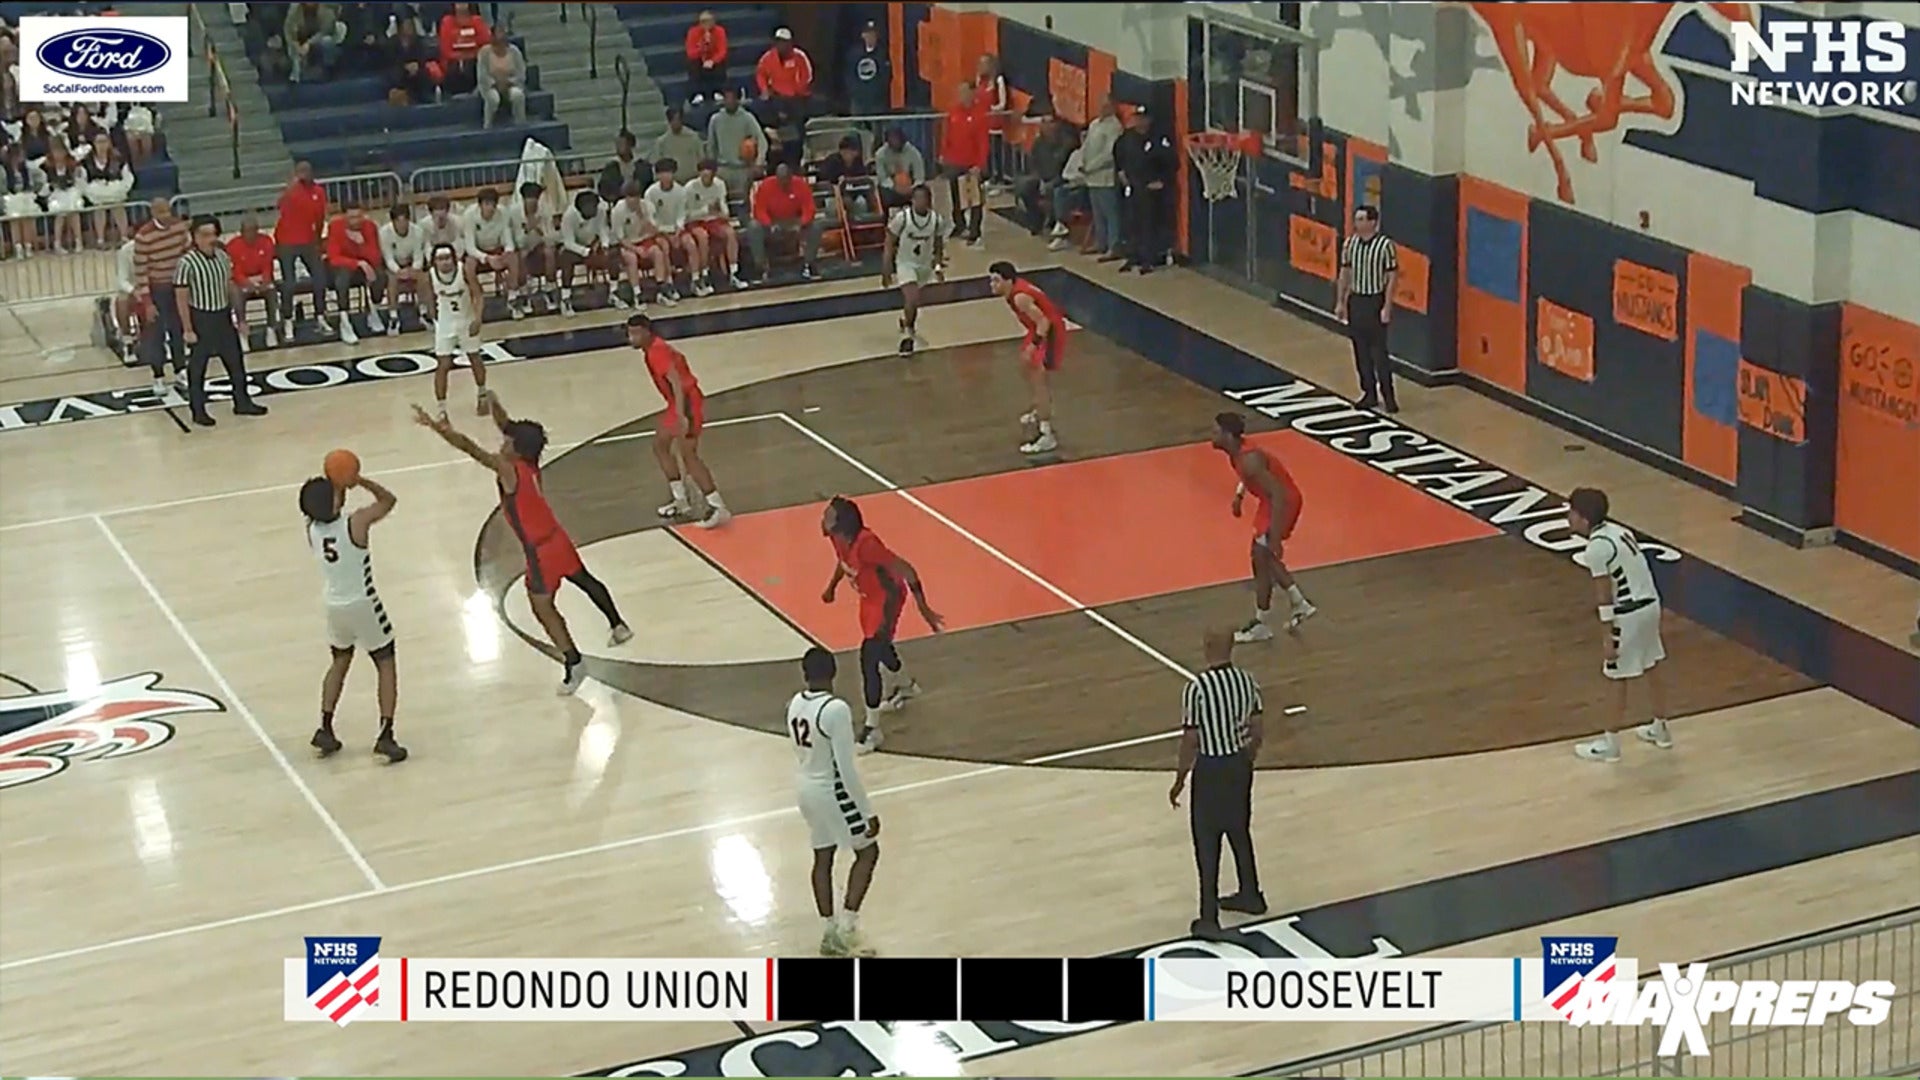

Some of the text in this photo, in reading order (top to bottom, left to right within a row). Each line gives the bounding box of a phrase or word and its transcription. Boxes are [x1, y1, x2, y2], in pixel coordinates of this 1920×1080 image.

[912, 244, 921, 255] 4
[450, 301, 460, 312] 2
[323, 537, 339, 563] 5
[791, 717, 812, 748] 12
